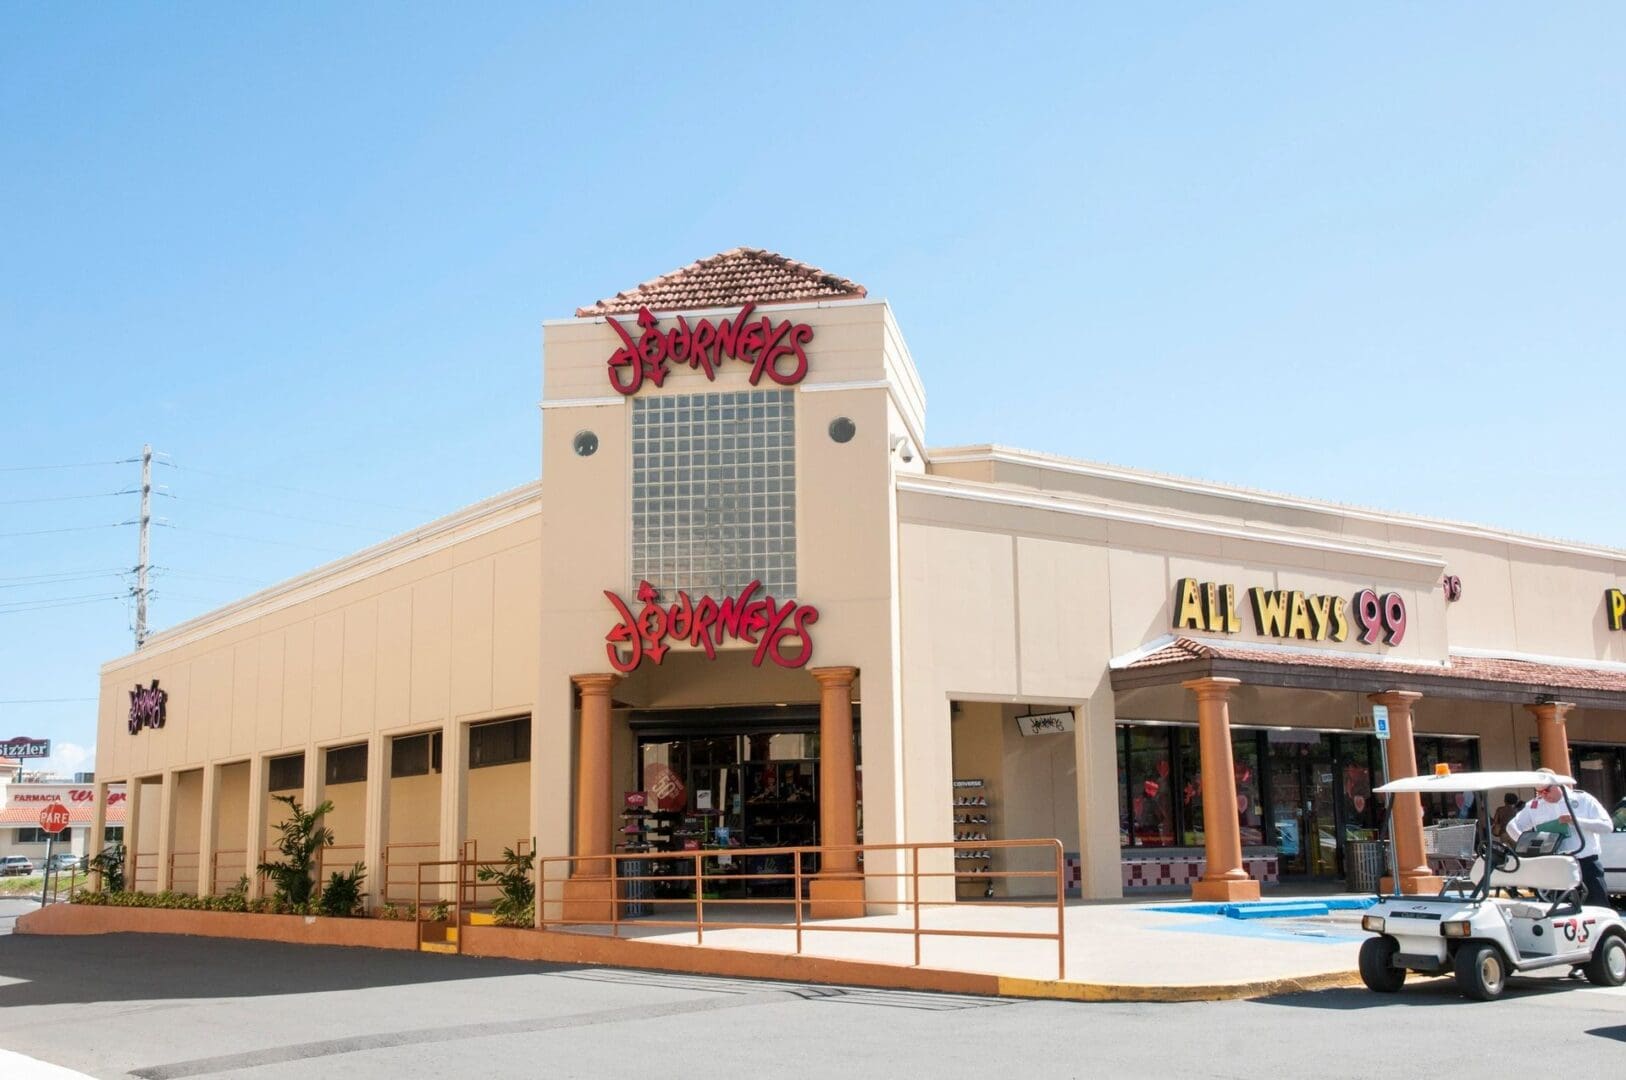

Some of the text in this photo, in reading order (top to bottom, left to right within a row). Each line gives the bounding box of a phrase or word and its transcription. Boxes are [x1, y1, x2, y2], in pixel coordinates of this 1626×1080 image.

[1173, 577, 1242, 634] ALL
[1249, 586, 1348, 643] WAYS
[1353, 588, 1407, 647] 99
[14, 794, 61, 802] FARMACIA
[40, 812, 69, 825] PARE
